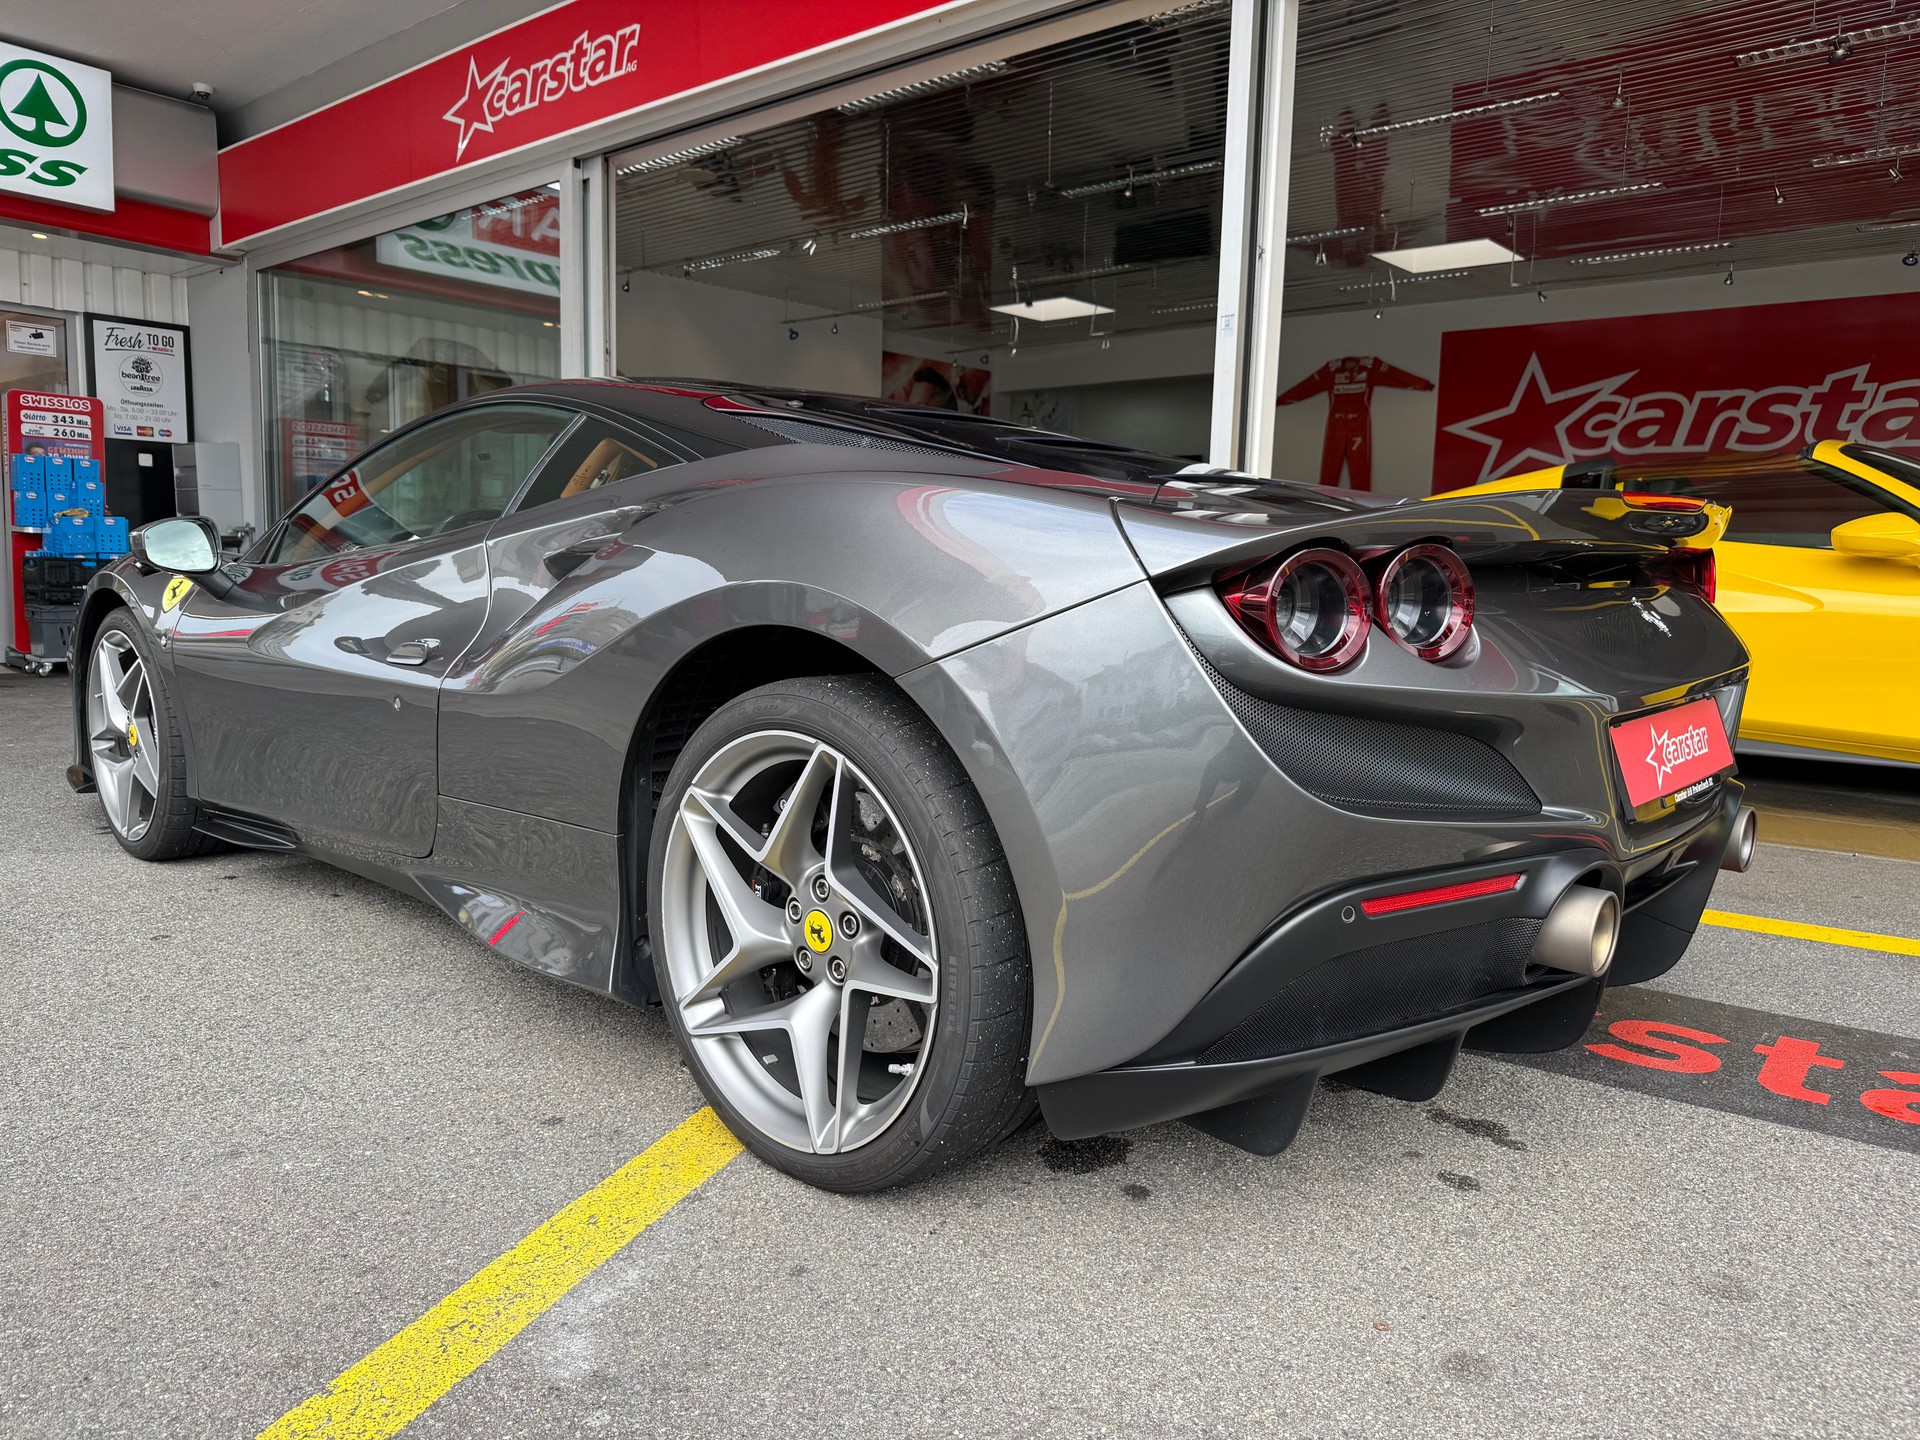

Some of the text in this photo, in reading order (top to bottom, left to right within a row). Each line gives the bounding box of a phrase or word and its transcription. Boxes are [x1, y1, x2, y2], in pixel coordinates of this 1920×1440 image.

[483, 24, 640, 122] carstar AG
[104, 327, 174, 349] Fresh TO GO
[20, 394, 91, 412] SWISSLOS
[120, 398, 164, 409] Öffnungszeiten
[1663, 725, 1708, 767] carstar
